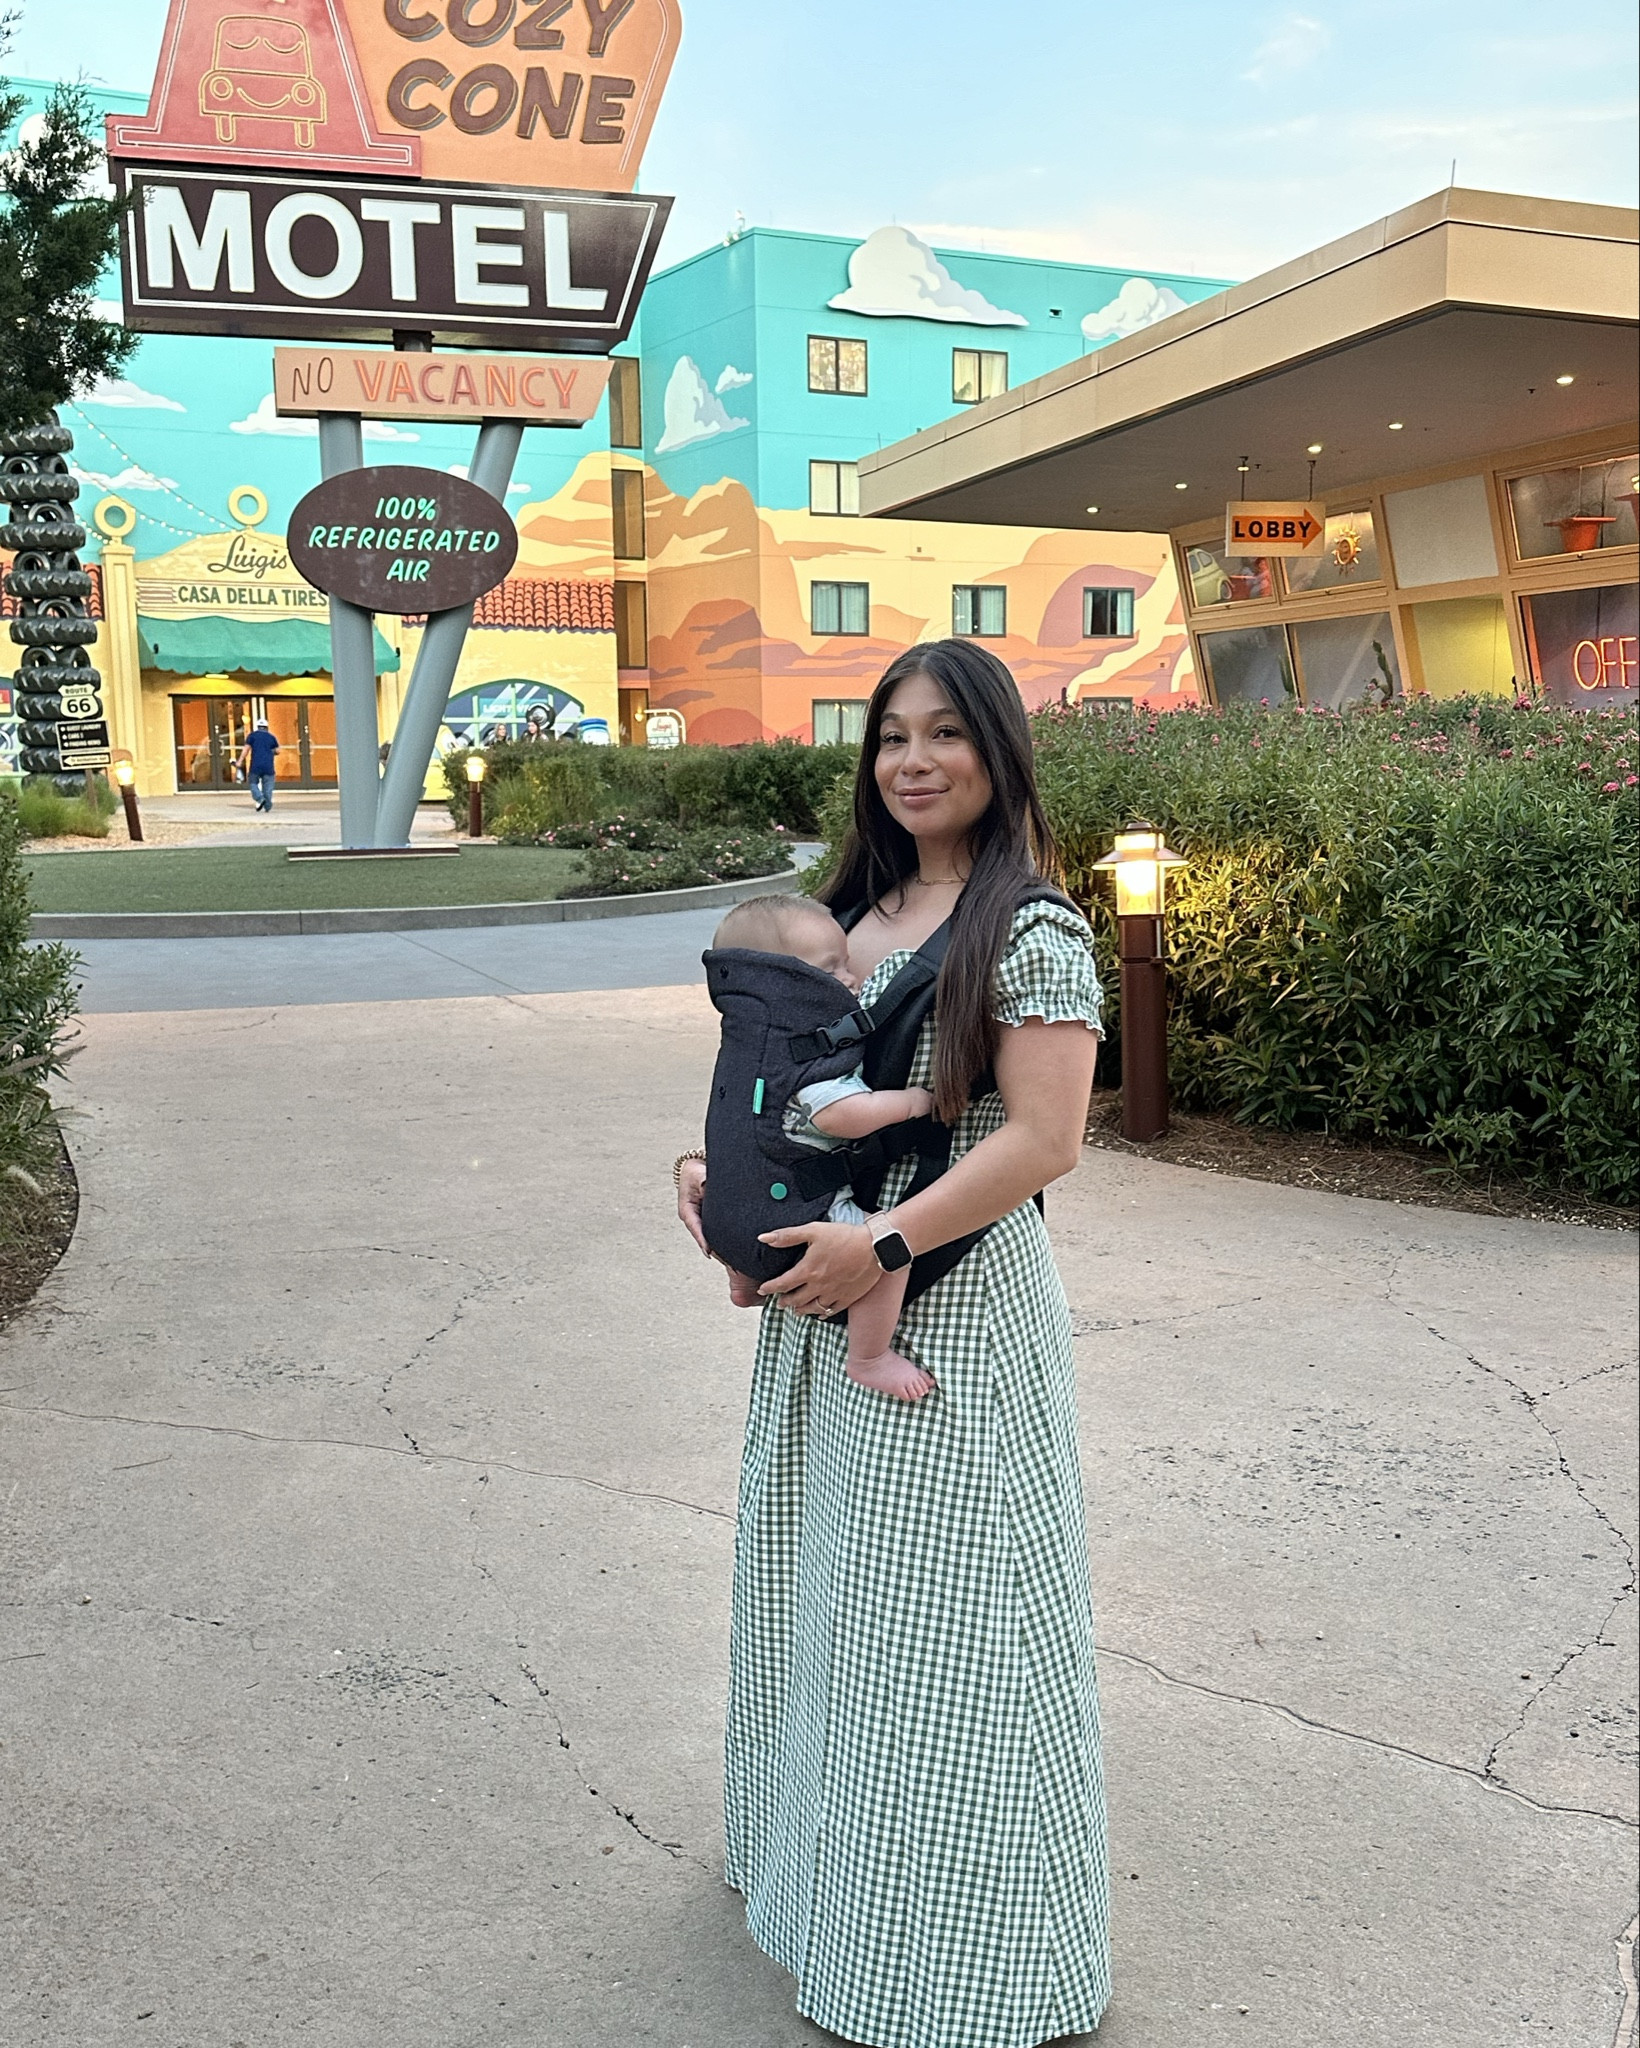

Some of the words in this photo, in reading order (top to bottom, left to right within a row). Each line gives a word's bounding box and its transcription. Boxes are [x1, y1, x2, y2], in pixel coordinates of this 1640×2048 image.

[383, 0, 636, 58] COZY
[386, 57, 637, 144] CONE
[141, 184, 609, 311] MOTEL
[292, 356, 334, 402] NO
[353, 358, 580, 409] VACANCY
[375, 496, 437, 521] 100%
[308, 525, 500, 553] REFRIGERATED
[1234, 520, 1312, 538] LOBBY
[386, 558, 431, 582] AIR
[178, 585, 221, 604] CASA
[227, 587, 278, 606] DELLA
[282, 589, 328, 607] TIRES
[1573, 636, 1637, 690] OFF
[67, 698, 91, 713] 66
